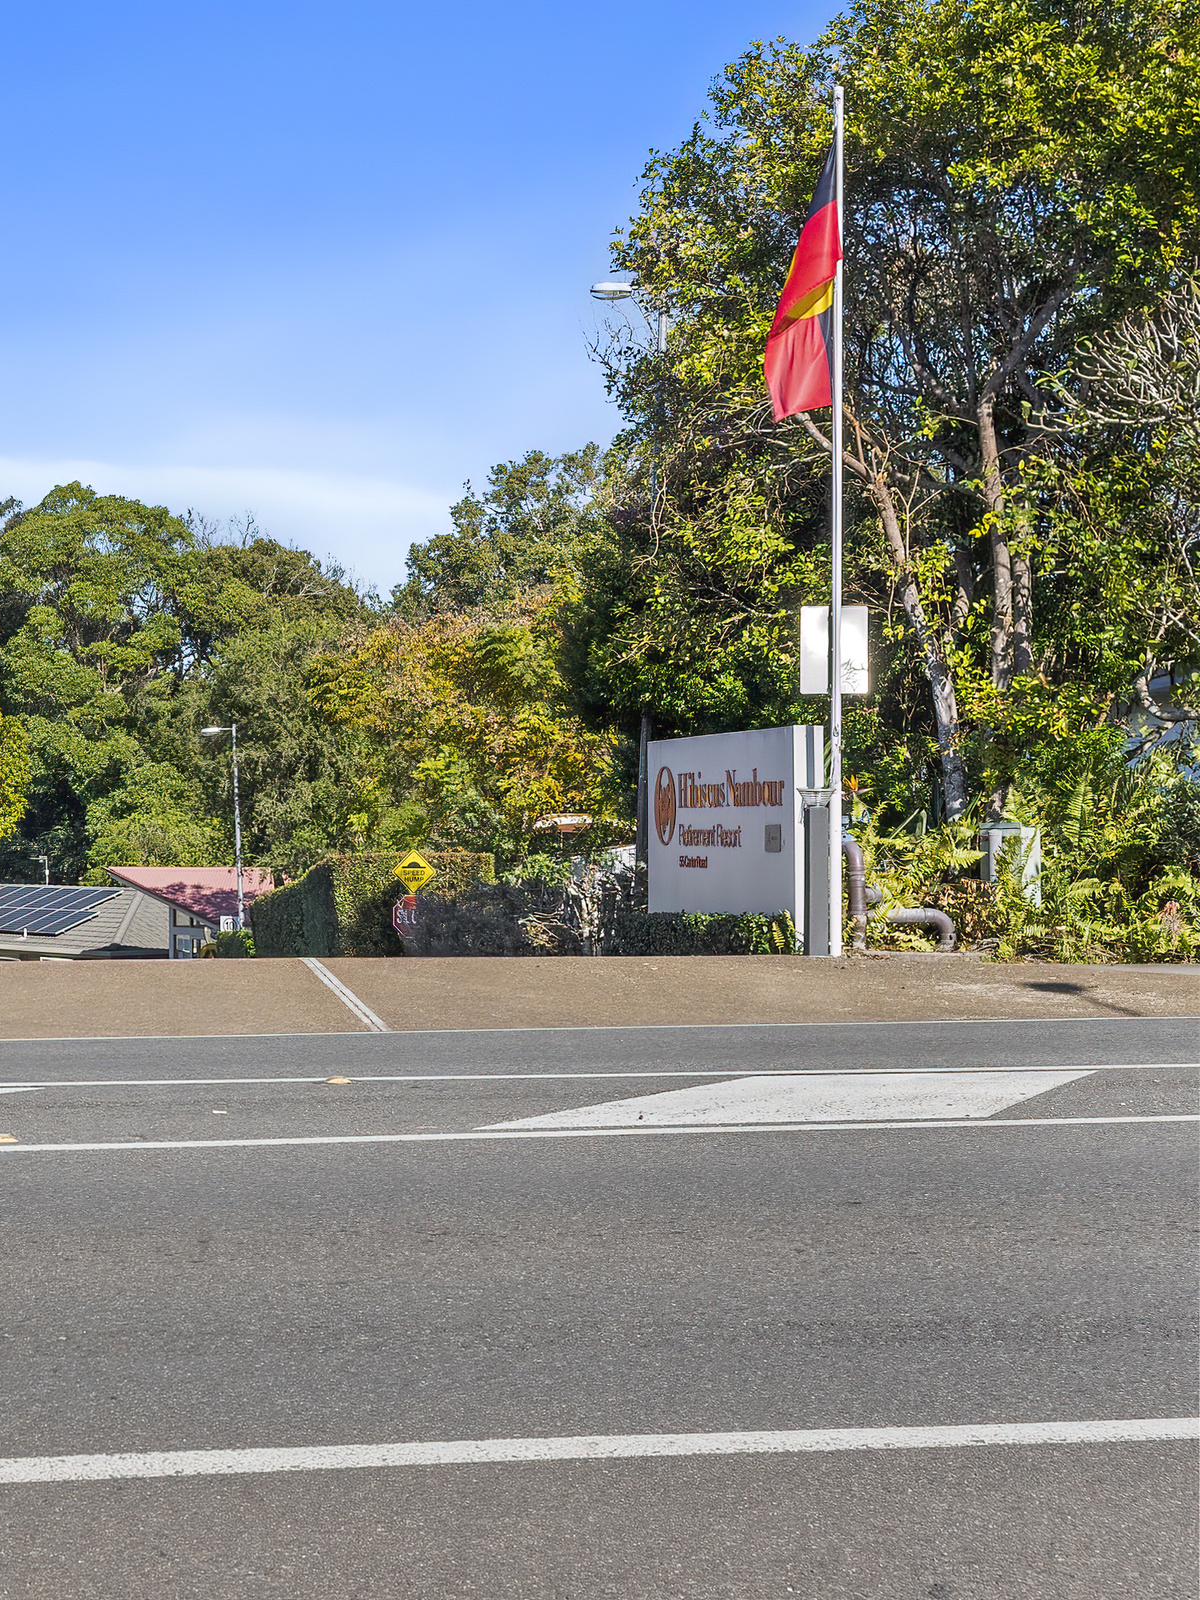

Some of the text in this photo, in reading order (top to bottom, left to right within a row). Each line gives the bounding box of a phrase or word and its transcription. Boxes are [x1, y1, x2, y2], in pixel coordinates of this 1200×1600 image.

[677, 767, 784, 808] Hibiscus Nambour
[679, 824, 742, 848] Retirement Resort
[226, 922, 234, 930] 10
